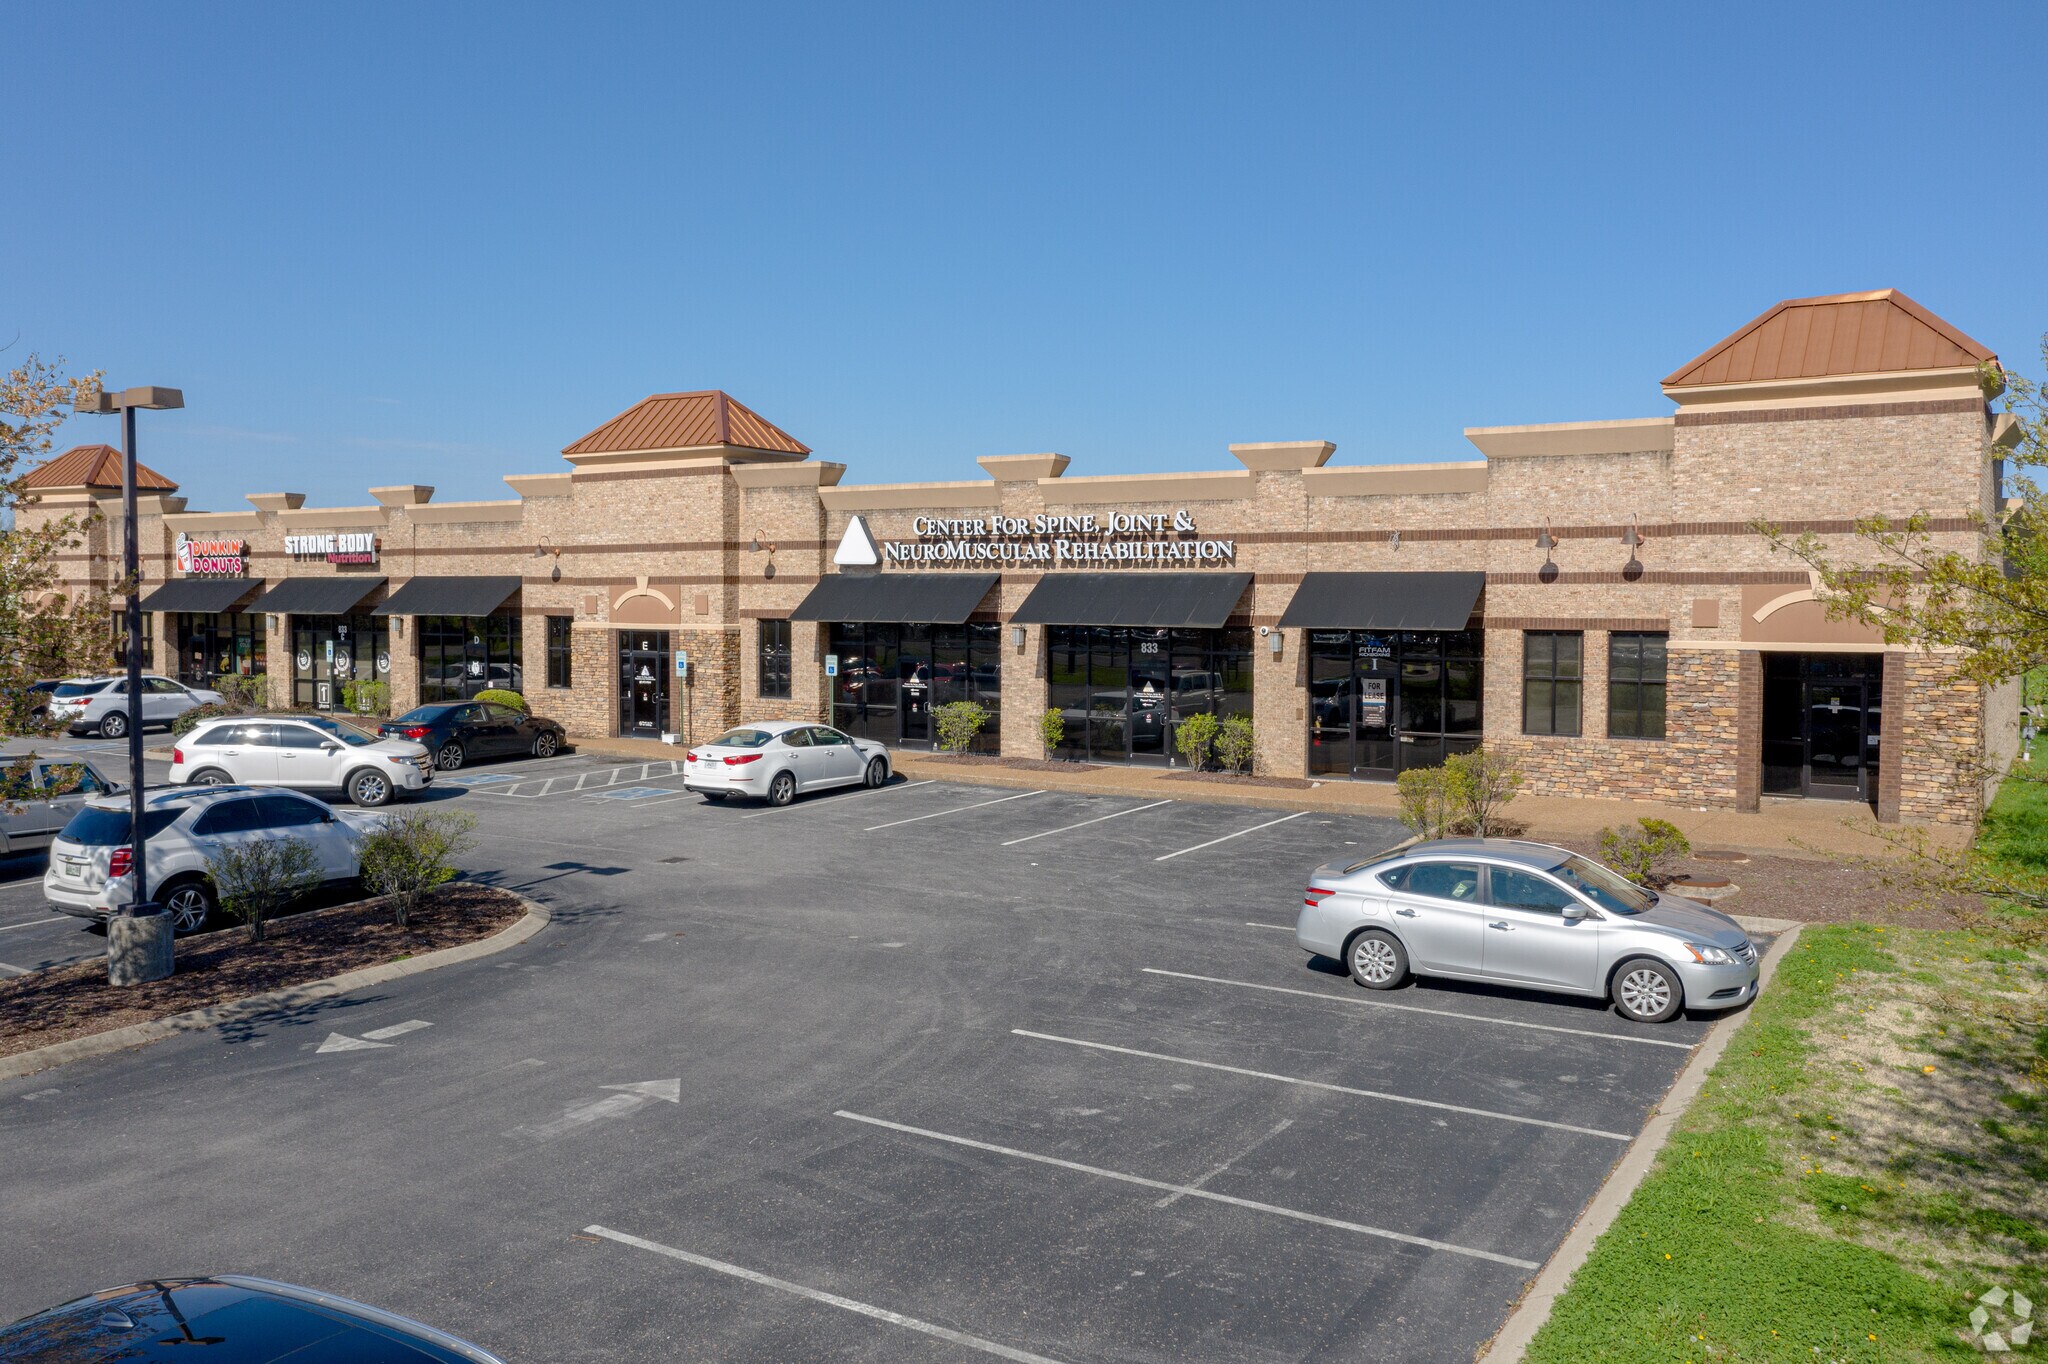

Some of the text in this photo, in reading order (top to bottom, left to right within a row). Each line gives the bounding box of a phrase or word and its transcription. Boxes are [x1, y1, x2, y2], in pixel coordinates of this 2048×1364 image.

[1173, 510, 1196, 532] &
[192, 539, 244, 557] DUNKIN'
[284, 532, 375, 554] STRONG BODY
[326, 552, 371, 564] Nutrition
[192, 556, 243, 574] DONUTS
[474, 636, 480, 644] D
[642, 641, 649, 651] E
[1140, 642, 1159, 654] 833
[1367, 682, 1381, 690] FOR
[1364, 691, 1385, 700] LEASE
